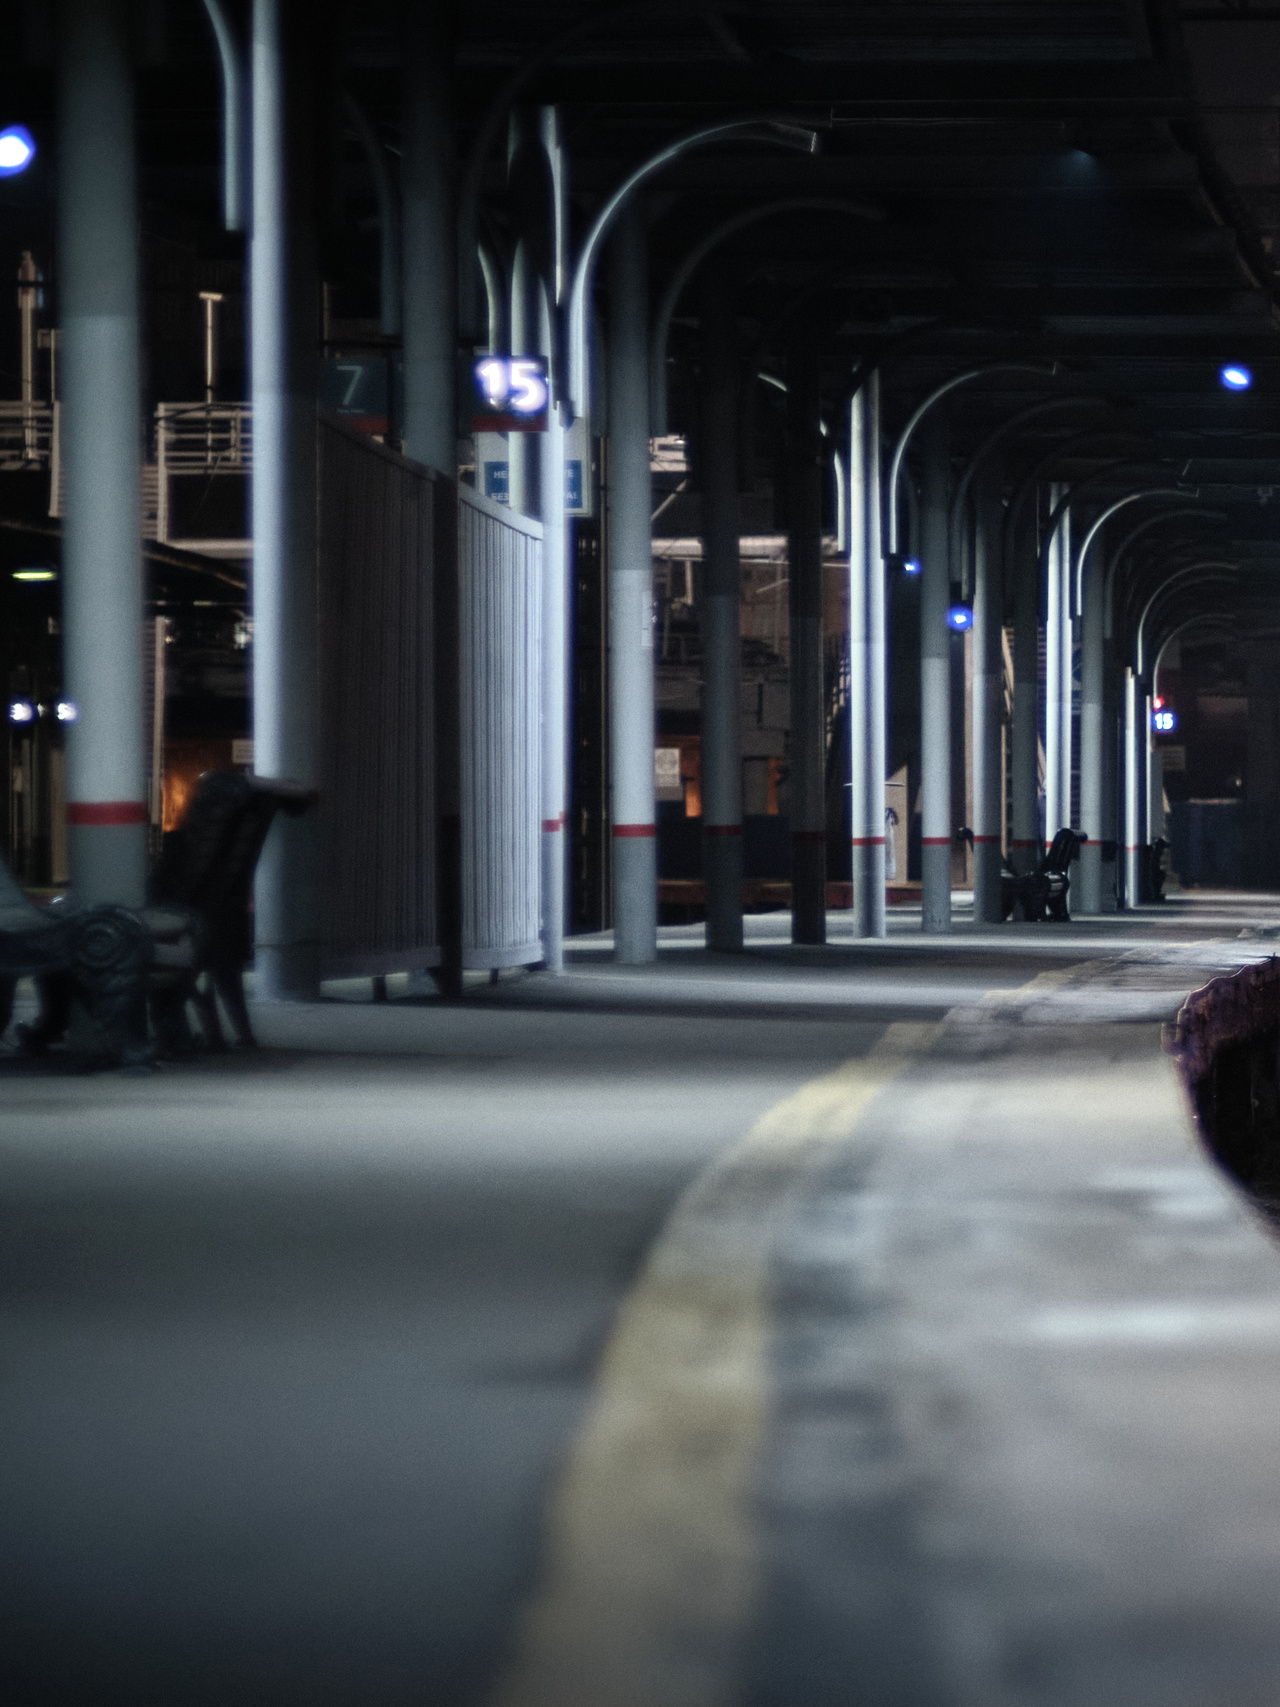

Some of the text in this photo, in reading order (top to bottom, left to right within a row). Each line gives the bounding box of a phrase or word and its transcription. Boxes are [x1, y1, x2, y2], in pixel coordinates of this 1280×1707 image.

[336, 364, 364, 406] 7
[477, 360, 547, 412] 15
[1154, 712, 1174, 730] 15
